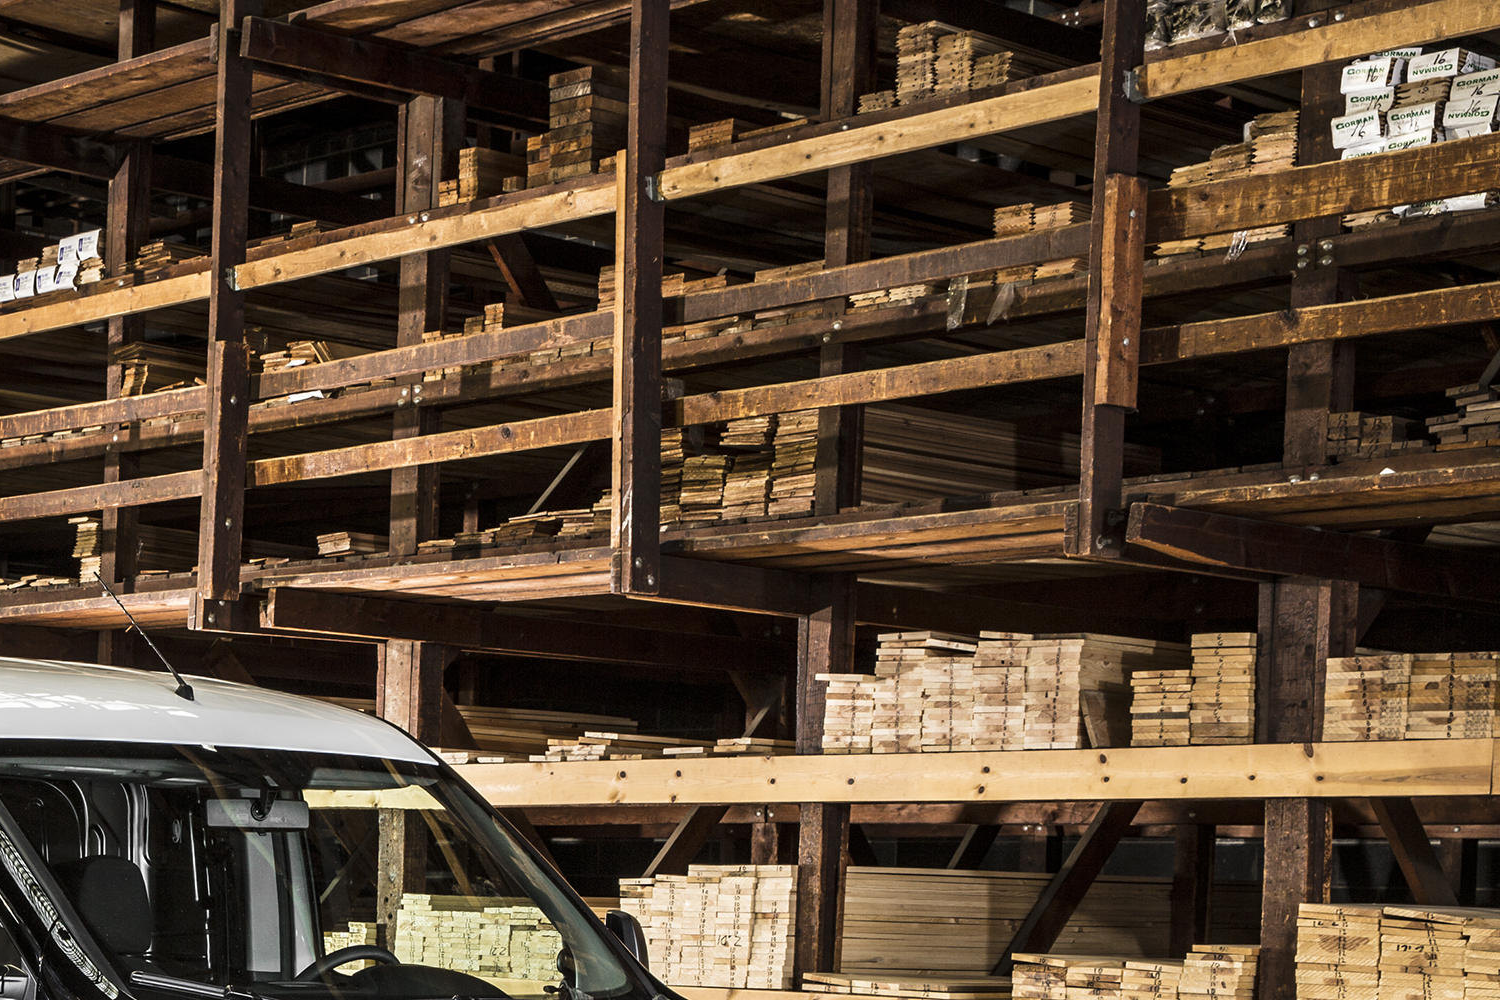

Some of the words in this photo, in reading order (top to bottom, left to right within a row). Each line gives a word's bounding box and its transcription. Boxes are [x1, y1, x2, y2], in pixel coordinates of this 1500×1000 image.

[1433, 51, 1448, 65] 16
[1347, 67, 1385, 75] GORMAN
[1412, 63, 1453, 76] GORMAN
[1456, 74, 1499, 87] GORMAN
[1470, 84, 1486, 97] 16
[1350, 93, 1390, 103] GORMAN
[1466, 100, 1481, 114] 16
[1390, 109, 1431, 121] GORMAN
[1447, 110, 1490, 119] GORMAN
[1335, 115, 1375, 130] GORMAN
[1388, 136, 1427, 149] GORMAN
